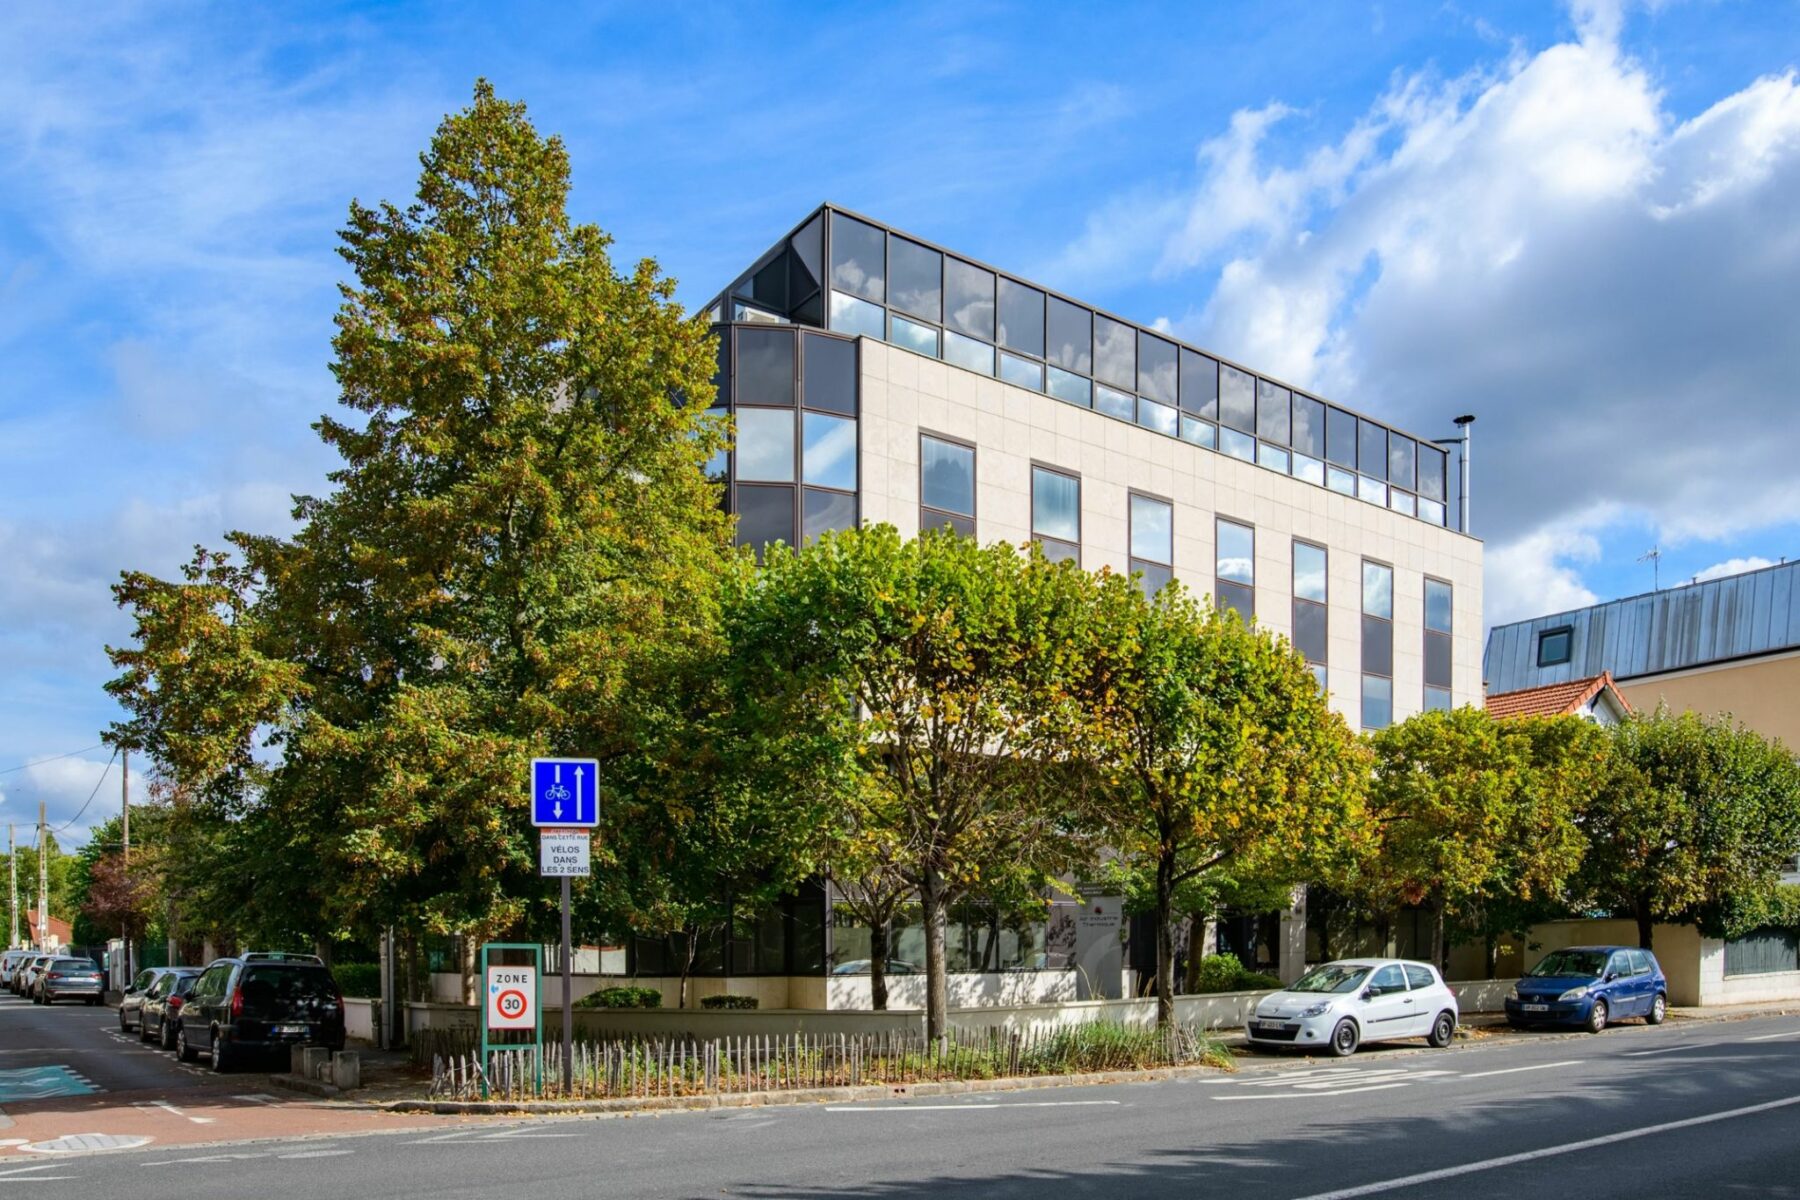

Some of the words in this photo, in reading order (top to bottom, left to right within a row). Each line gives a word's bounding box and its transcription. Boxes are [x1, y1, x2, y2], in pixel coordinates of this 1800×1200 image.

[551, 845, 580, 853] VÉLOS
[496, 975, 527, 983] ZONE
[505, 999, 520, 1009] 30
